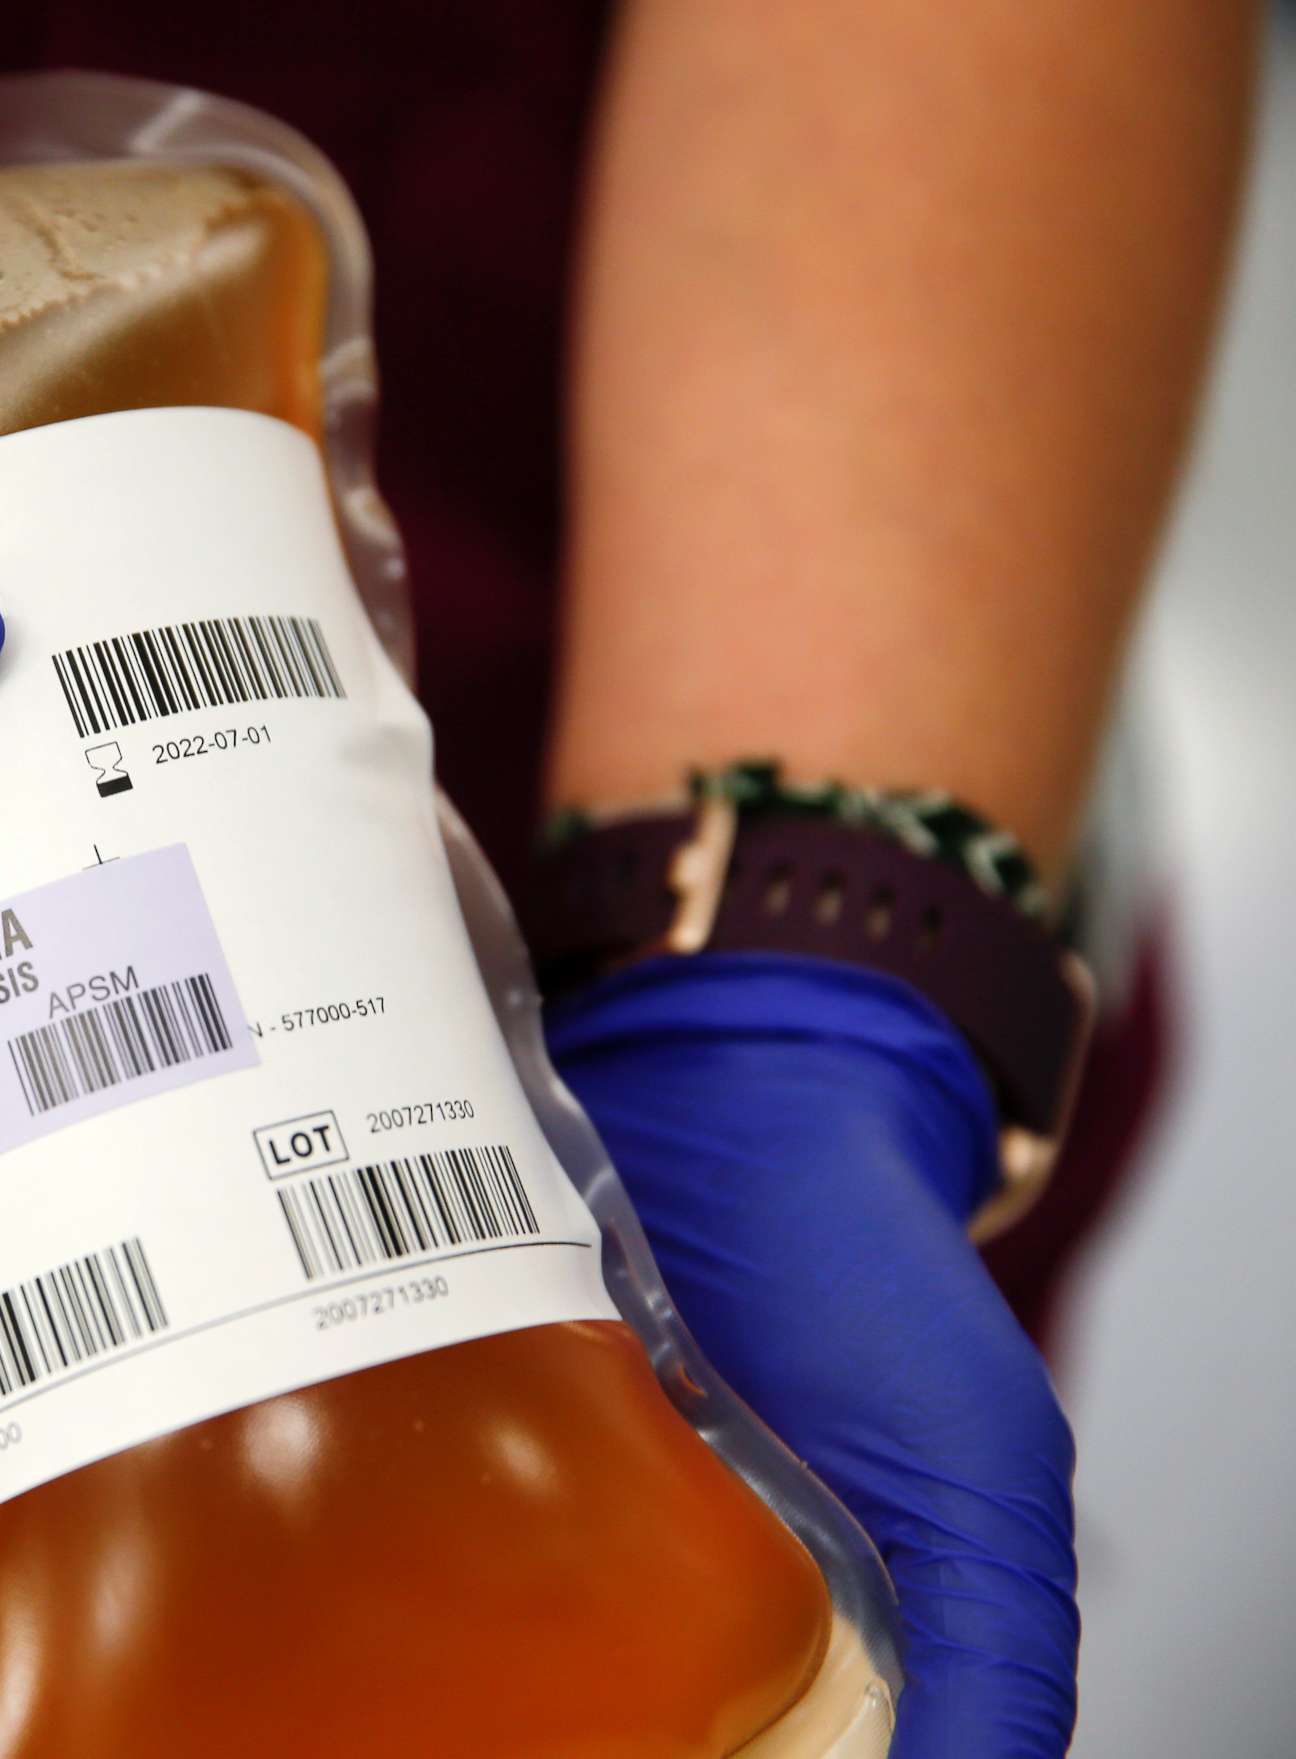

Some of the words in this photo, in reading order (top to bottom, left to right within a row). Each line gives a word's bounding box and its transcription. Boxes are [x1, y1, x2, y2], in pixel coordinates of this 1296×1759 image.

[152, 725, 271, 764] 2022-07-01
[49, 965, 139, 1019] APSM
[281, 997, 385, 1031] 577000-517
[366, 1099, 475, 1133] 2007271330
[268, 1125, 331, 1165] LOT
[314, 1275, 449, 1330] 2007271330
